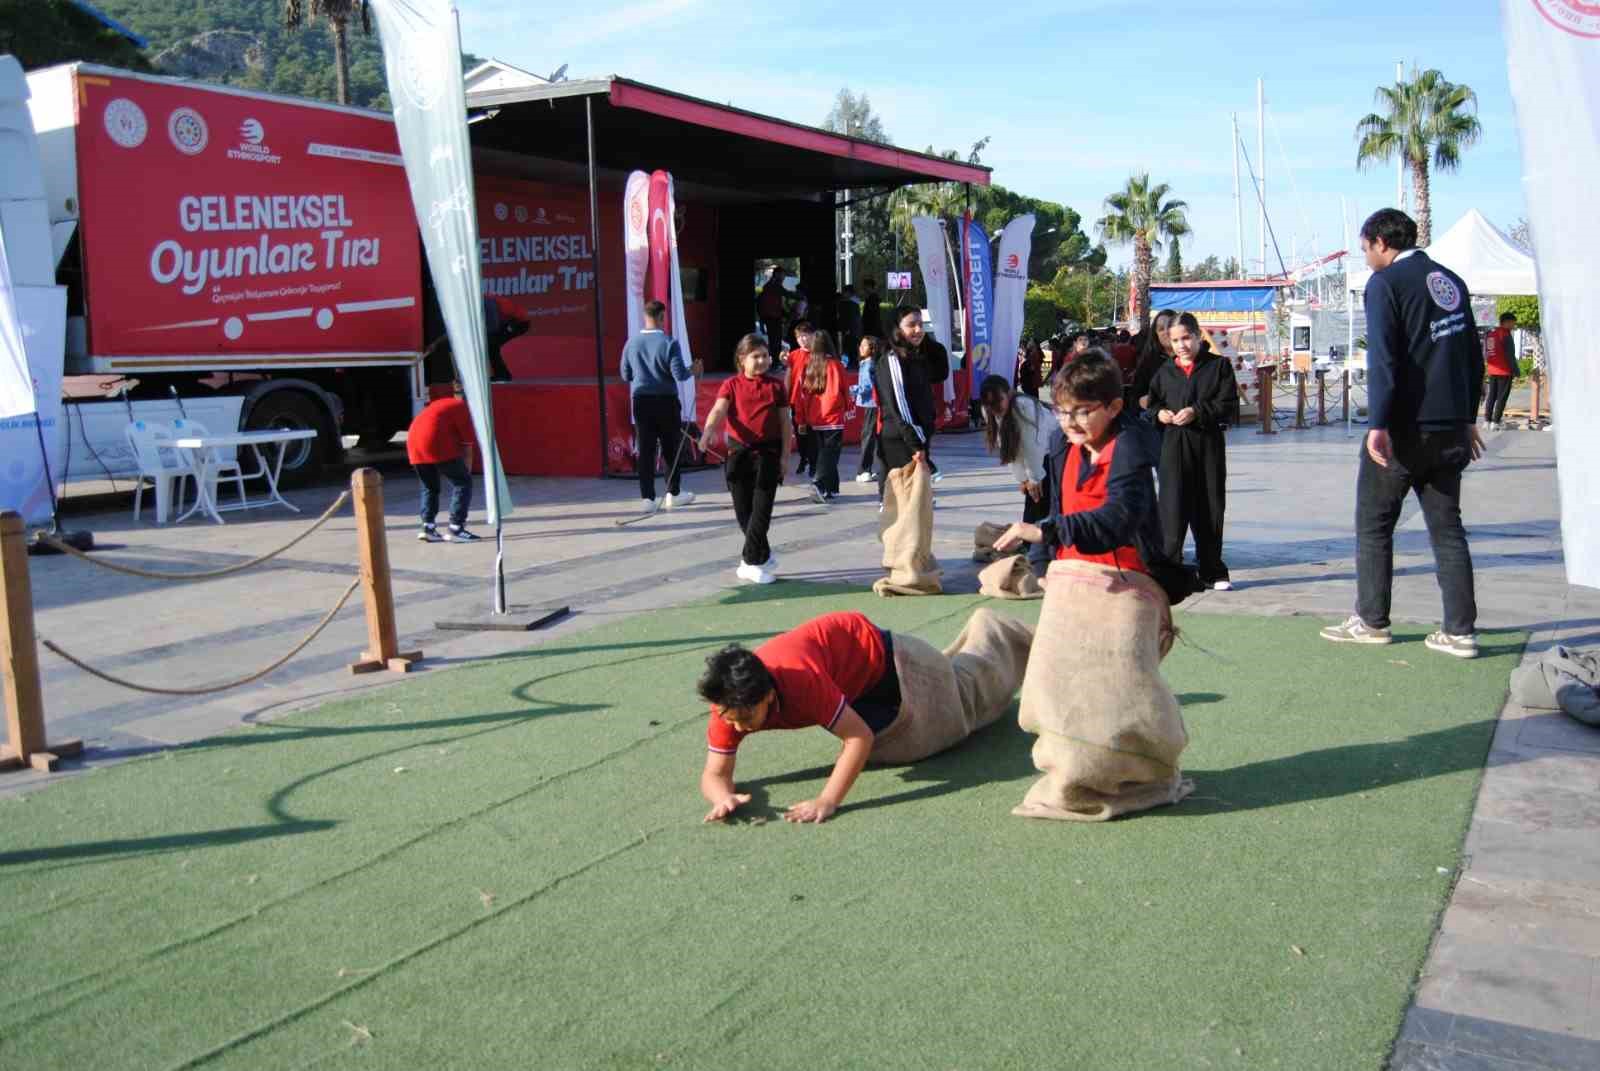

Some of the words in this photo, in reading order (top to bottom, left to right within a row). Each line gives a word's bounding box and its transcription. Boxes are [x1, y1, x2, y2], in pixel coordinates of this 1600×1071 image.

[179, 195, 353, 232] GELENEKSEL
[151, 233, 317, 294] Oyunlar
[480, 234, 593, 264] ELENEKSEL
